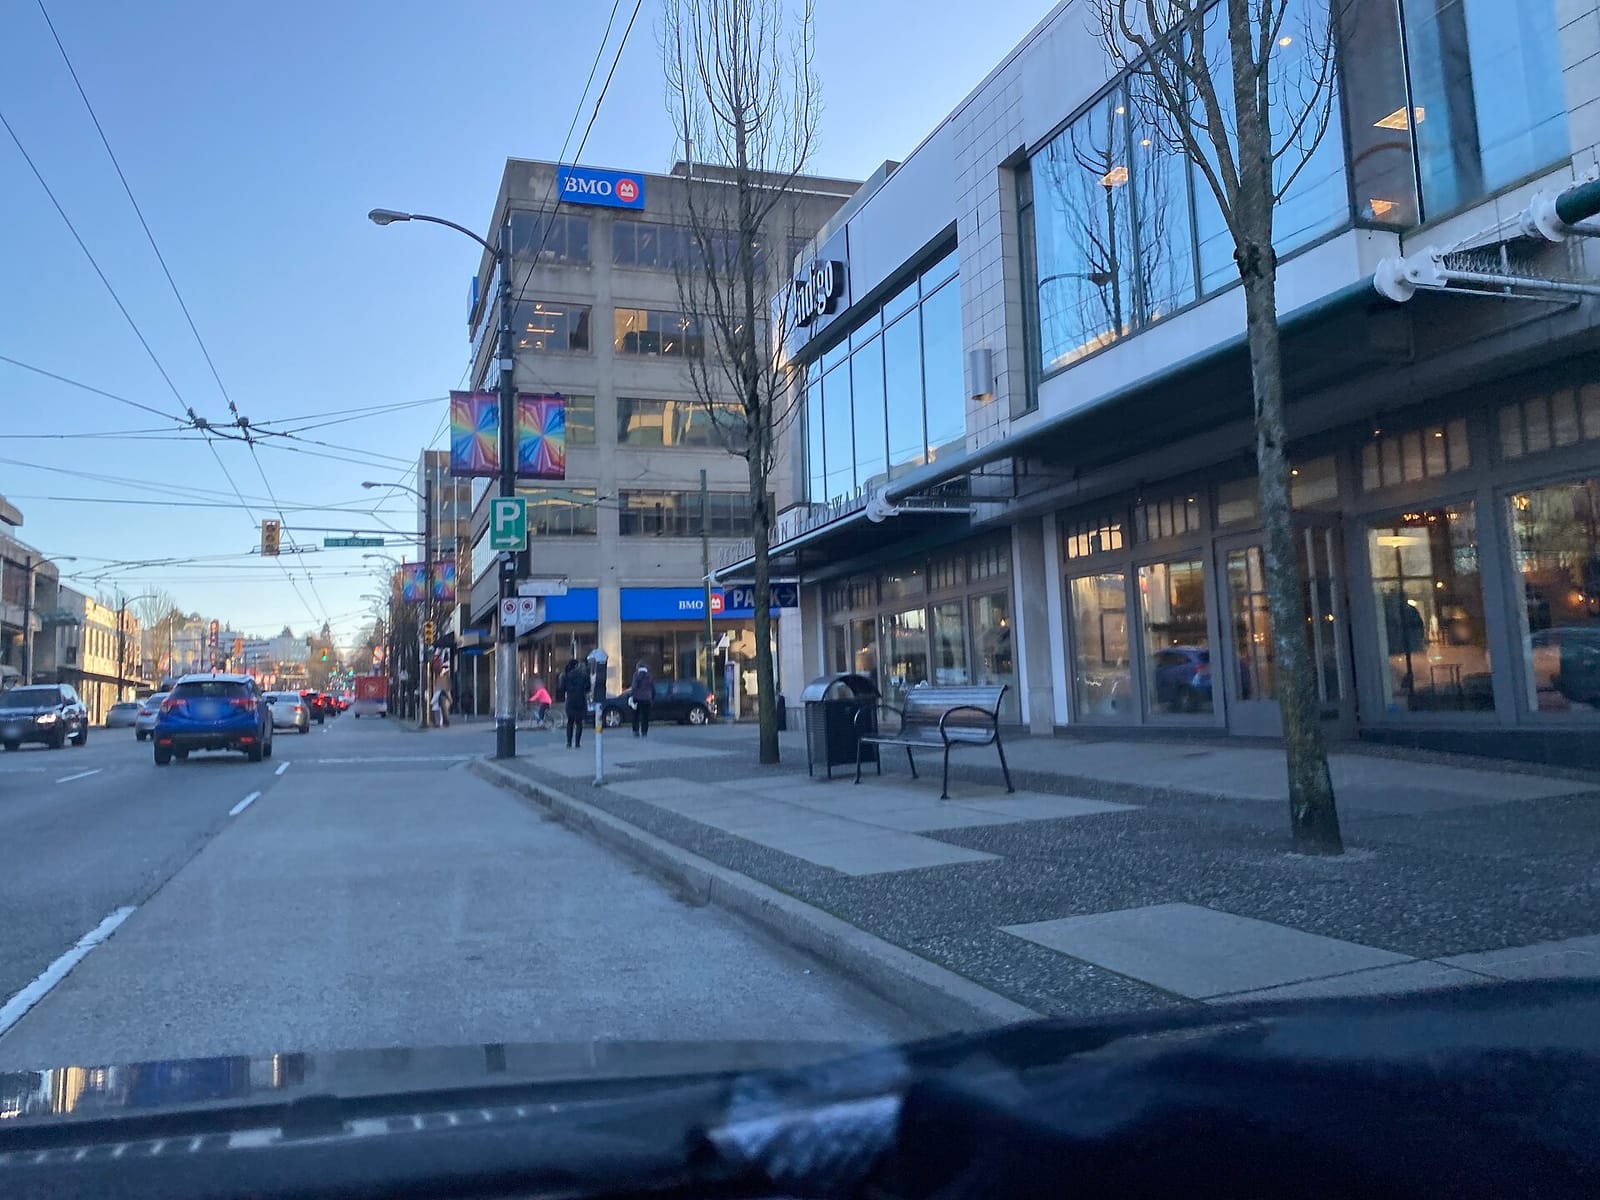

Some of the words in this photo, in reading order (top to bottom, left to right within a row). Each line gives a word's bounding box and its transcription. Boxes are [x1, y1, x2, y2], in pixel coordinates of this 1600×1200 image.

[564, 176, 612, 196] BMO
[496, 501, 520, 531] P
[679, 600, 703, 610] BMO
[733, 588, 780, 608] PAK
